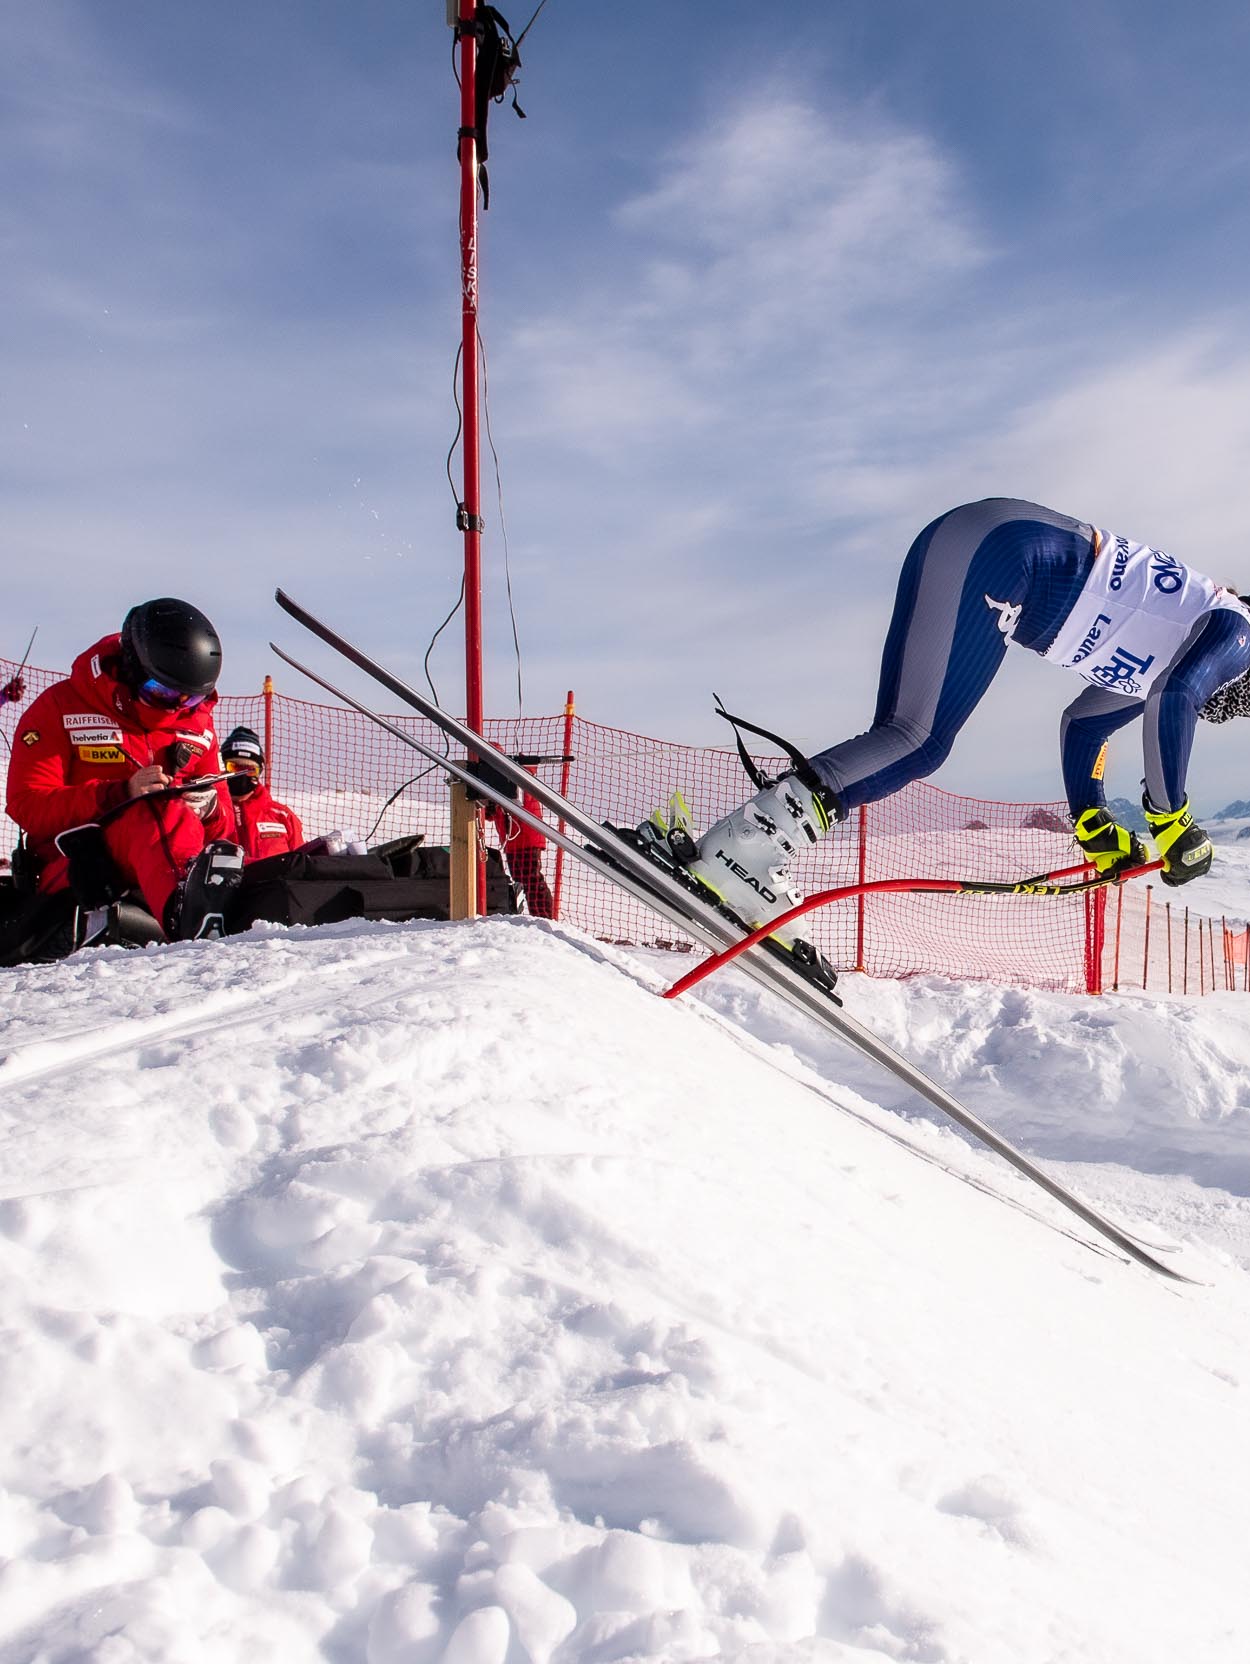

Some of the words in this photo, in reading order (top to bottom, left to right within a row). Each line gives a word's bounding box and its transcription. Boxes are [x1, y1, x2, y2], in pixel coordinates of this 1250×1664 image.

[1072, 613, 1112, 664] Laura
[72, 733, 109, 742] helvetia
[91, 750, 120, 760] BKW
[715, 849, 777, 904] HEAD
[1013, 884, 1061, 895] LEKI
